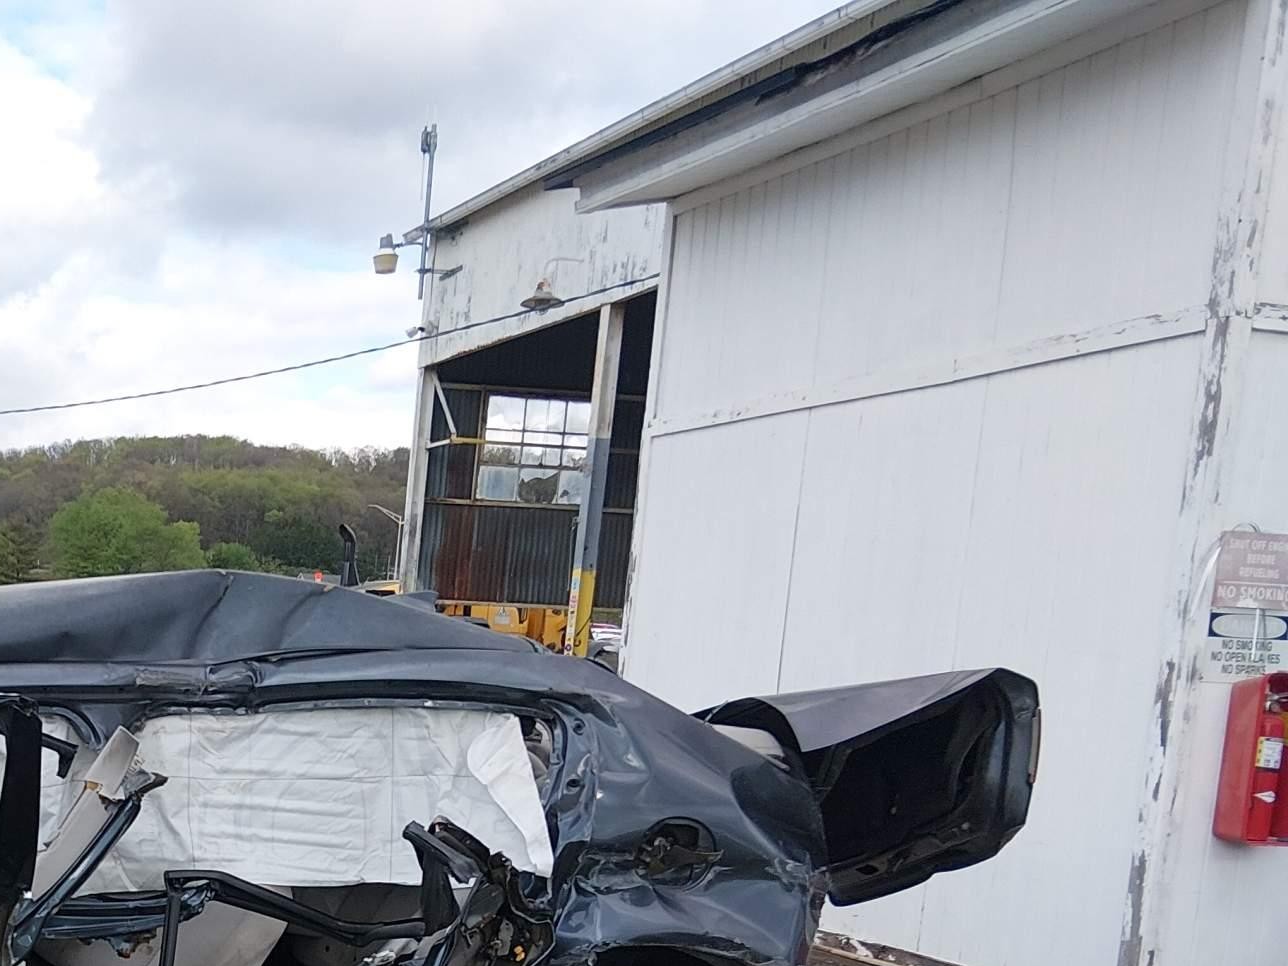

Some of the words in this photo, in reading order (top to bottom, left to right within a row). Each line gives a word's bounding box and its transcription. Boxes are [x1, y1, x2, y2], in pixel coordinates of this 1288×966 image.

[1216, 585, 1237, 599] NO
[1222, 639, 1233, 650] NO
[1211, 651, 1222, 662] NO
[1224, 652, 1245, 663] OPEN
[1221, 664, 1233, 674] NO
